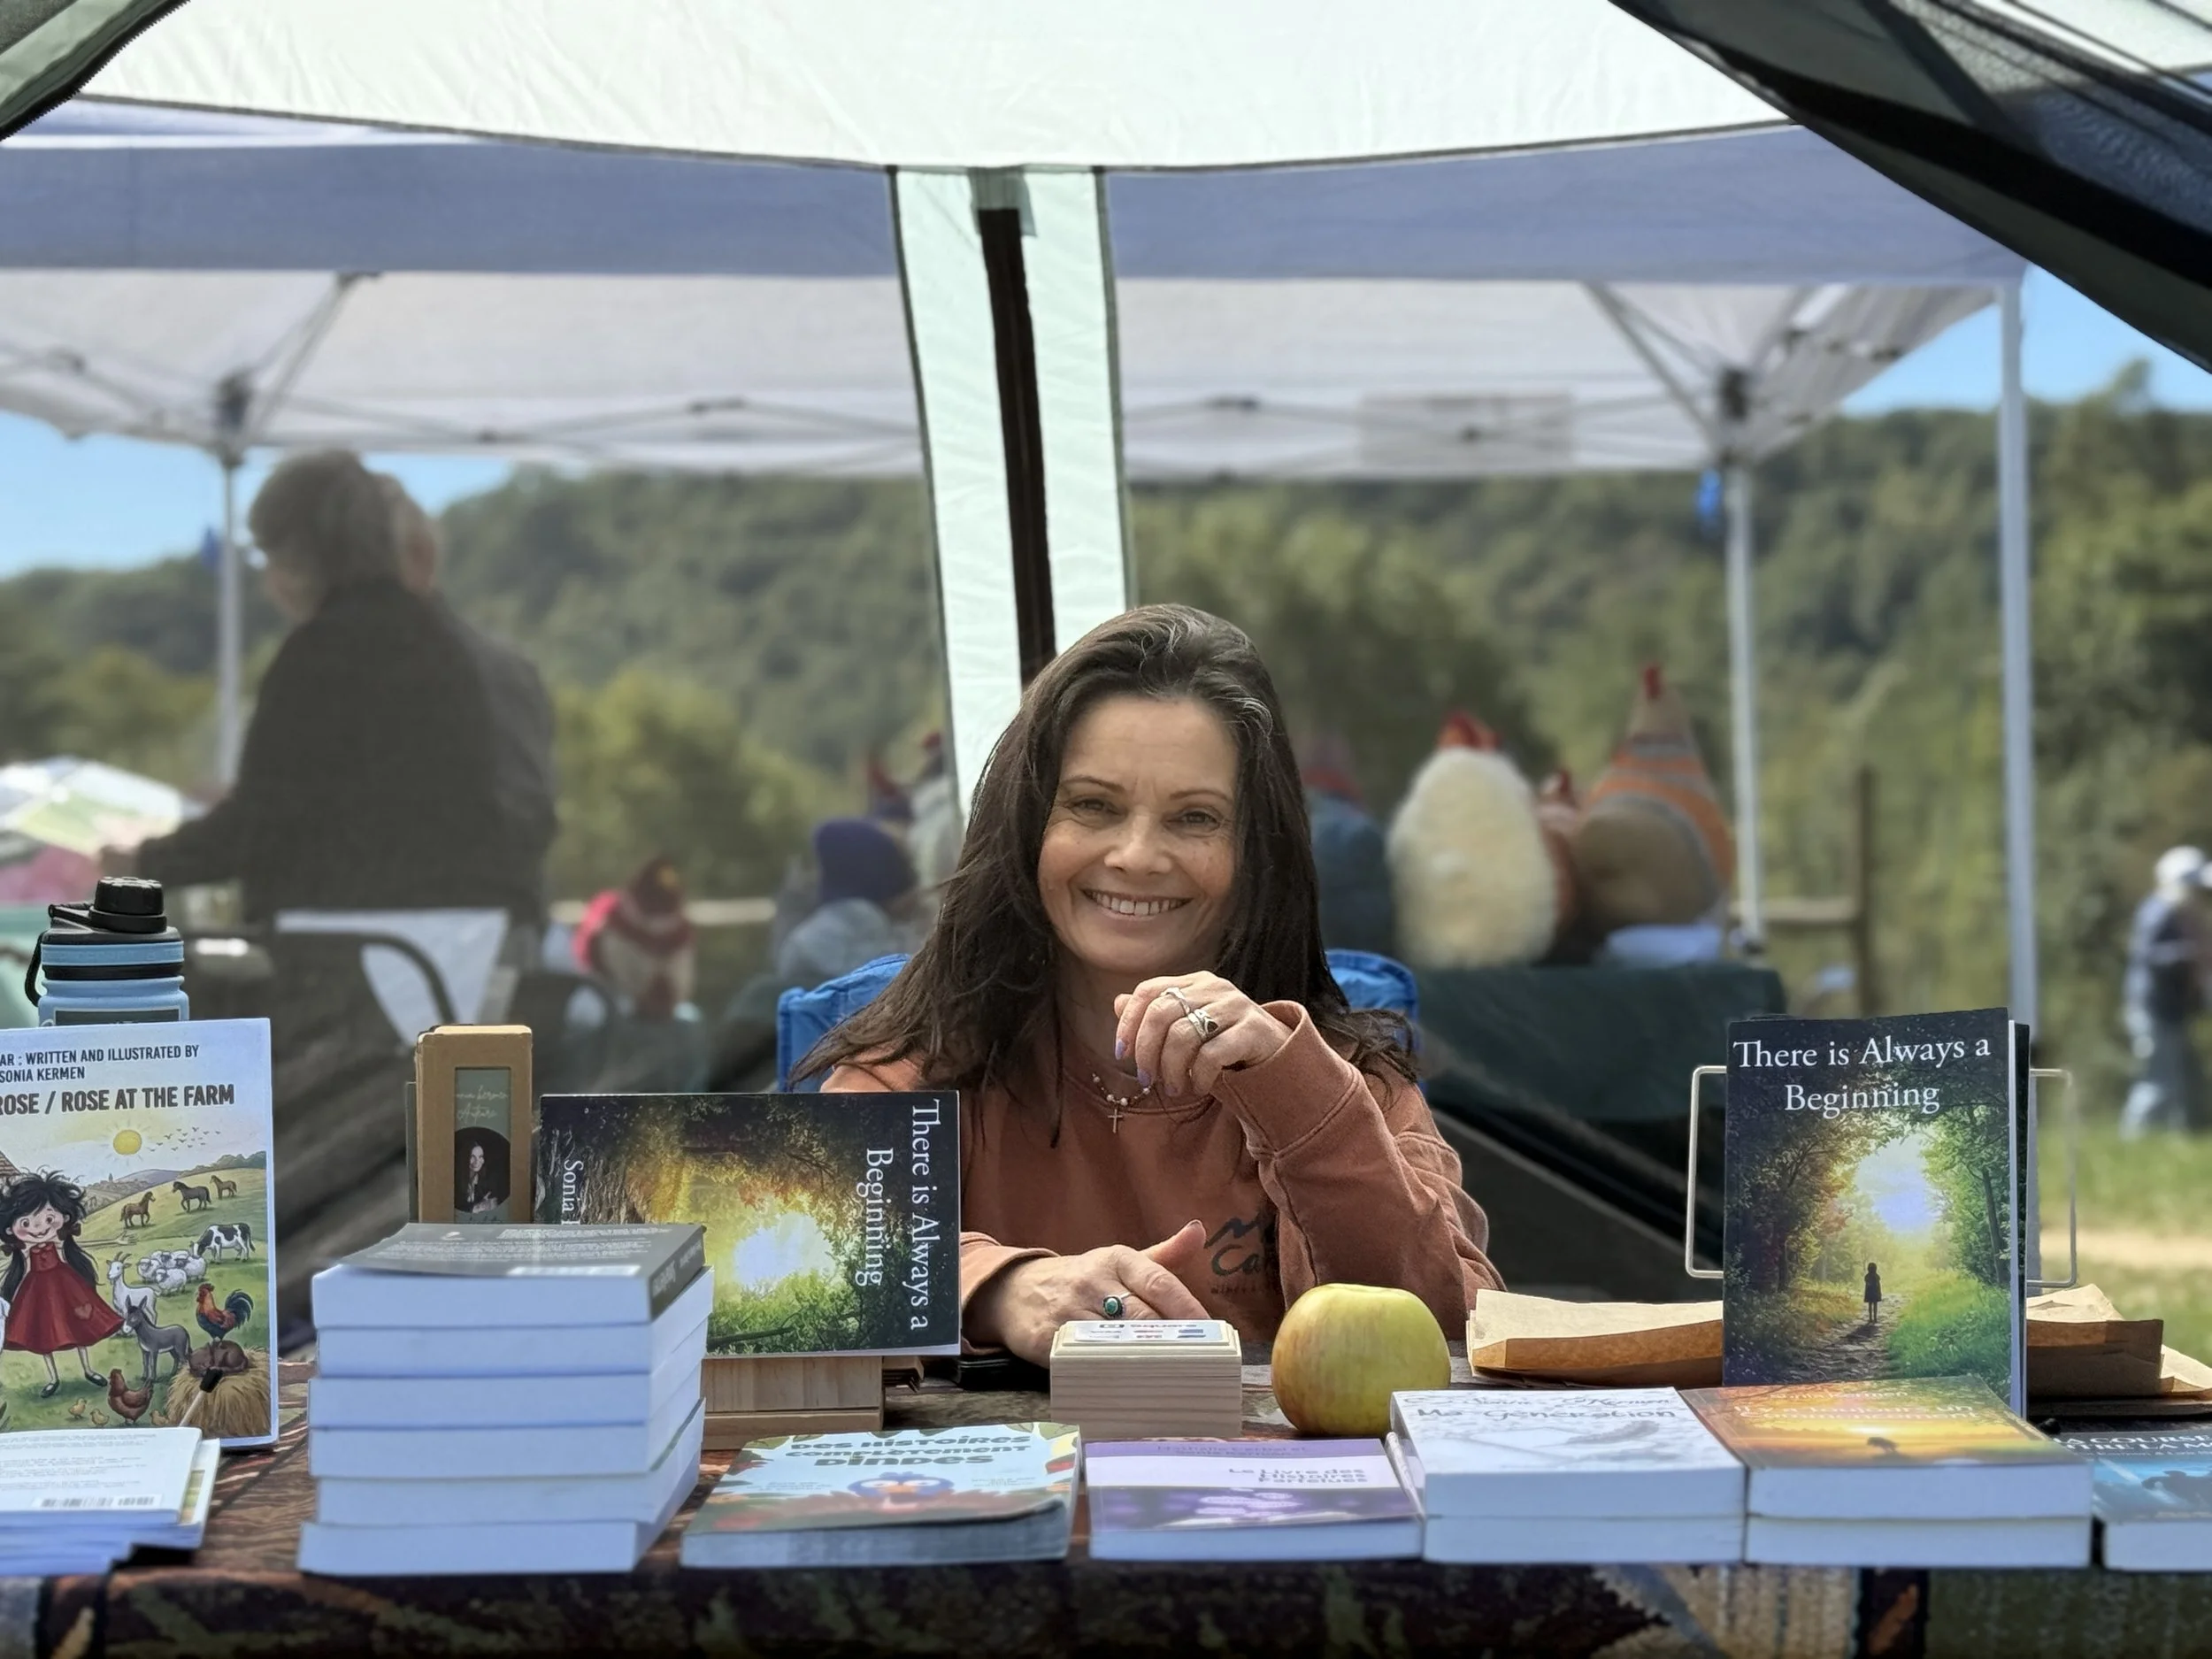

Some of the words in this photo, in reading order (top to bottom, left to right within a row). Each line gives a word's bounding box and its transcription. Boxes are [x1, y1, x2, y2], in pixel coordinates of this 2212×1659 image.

[26, 1050, 77, 1064] WRITTEN
[81, 1048, 104, 1063] AND
[108, 1045, 181, 1061] ILLUSTRATED
[185, 1045, 200, 1057] BY
[1732, 1040, 1818, 1068] There
[1828, 1041, 1850, 1066] is
[1859, 1035, 1965, 1068] Always
[1975, 1038, 1991, 1057] a
[0, 1068, 34, 1083] SONIA
[37, 1066, 85, 1081] KERMEN
[61, 1089, 110, 1112] ROSE
[115, 1087, 136, 1110] AT
[142, 1087, 178, 1108] THE
[184, 1084, 234, 1107] FARM
[1784, 1081, 1940, 1119] Beginning
[911, 1098, 941, 1176] There
[561, 1159, 584, 1213] Sonia
[911, 1185, 938, 1204] is
[855, 1148, 894, 1287] Beginning
[902, 1214, 941, 1307] Always
[910, 1316, 928, 1331] a
